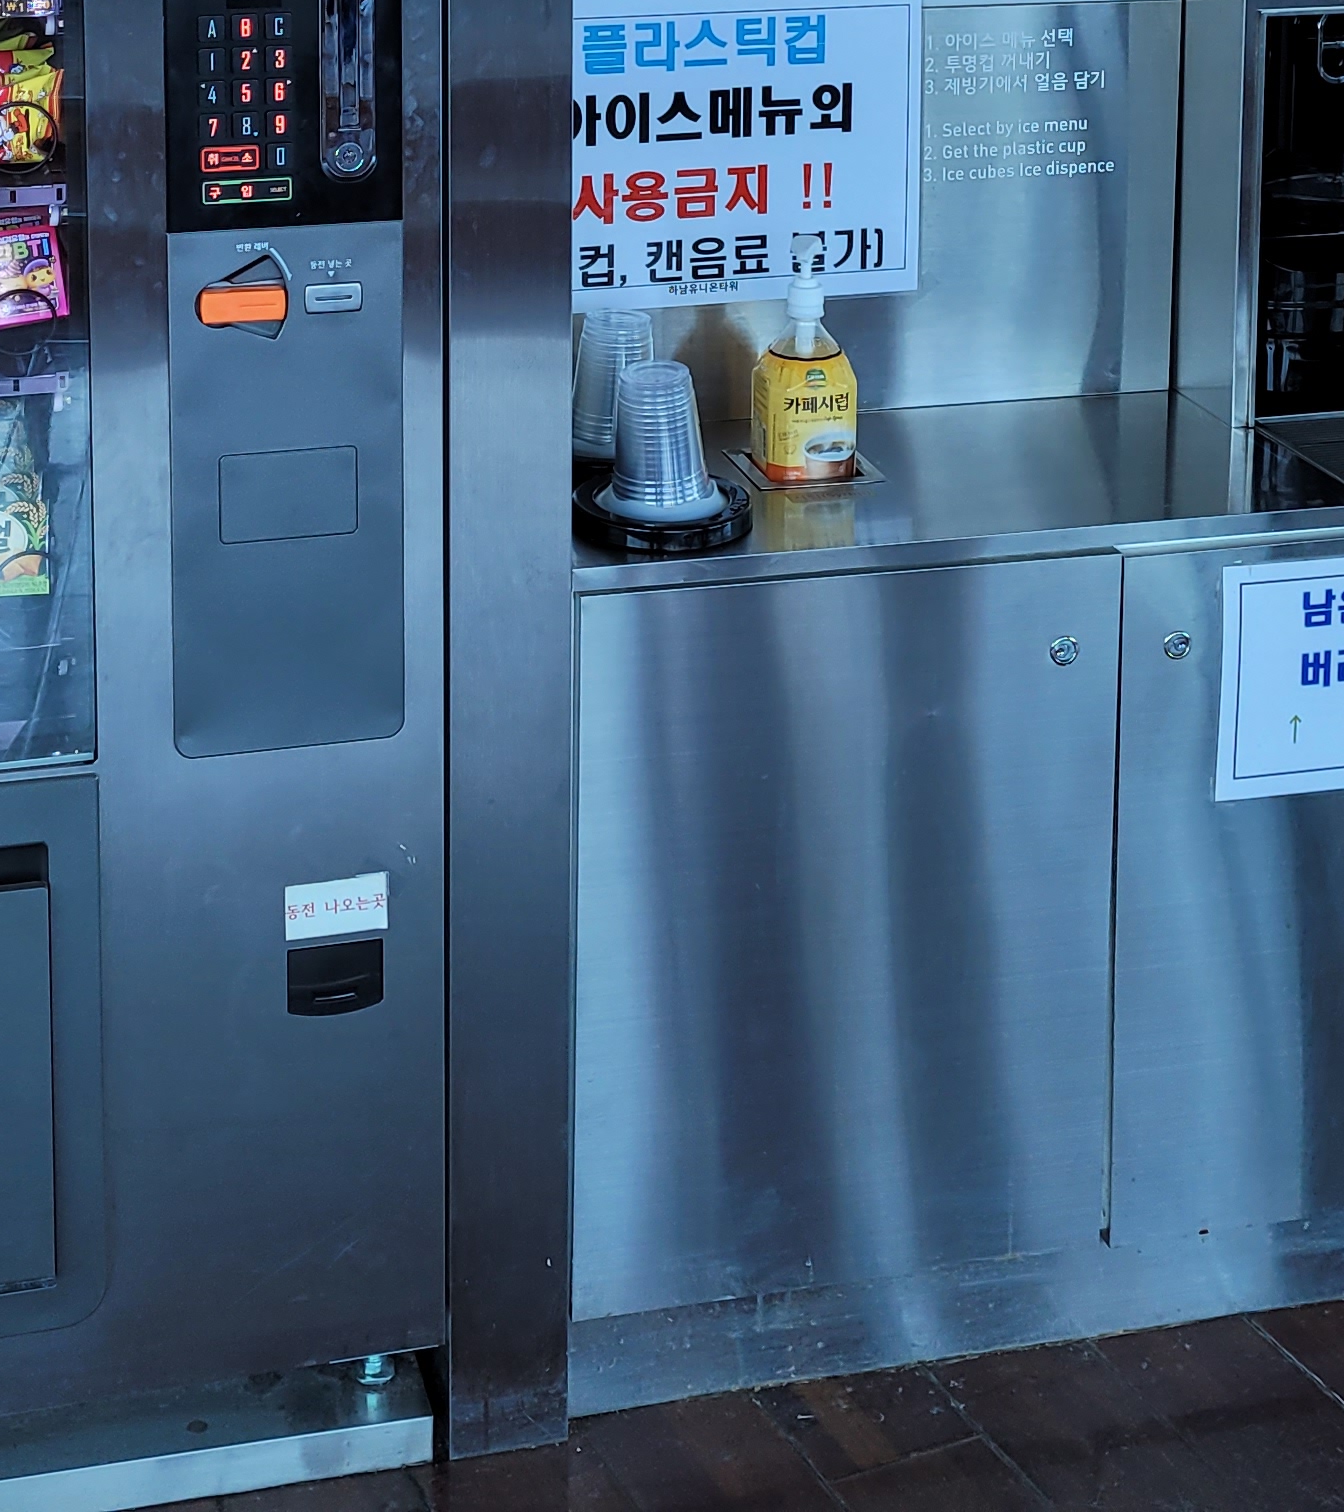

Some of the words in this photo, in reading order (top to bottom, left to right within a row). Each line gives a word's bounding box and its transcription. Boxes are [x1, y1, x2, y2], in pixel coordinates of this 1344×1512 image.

[582, 14, 827, 75] 플라스틱컵
[926, 35, 940, 51] 1.
[944, 33, 996, 51] 아이스
[1002, 32, 1036, 49] 메뉴
[1041, 27, 1073, 48] 선택
[925, 58, 939, 73] 2.
[945, 54, 994, 73] 투명컵
[1001, 51, 1050, 70] 꺼내기
[925, 79, 939, 95] 3.
[944, 74, 1028, 96] 제빙기에서
[1034, 72, 1068, 92] 얼음
[1074, 70, 1105, 90] 담기
[572, 82, 854, 147] 아이스메뉴외
[925, 124, 937, 138] 1.
[942, 122, 991, 138] Select
[996, 120, 1013, 136] by
[1018, 120, 1039, 133] ice
[1044, 117, 1088, 132] menu
[924, 145, 937, 160] 2.
[942, 145, 969, 160] Get
[973, 143, 998, 158] the
[1003, 139, 1054, 159] plastic
[1059, 140, 1086, 155] cup
[923, 167, 937, 182] 3.
[942, 167, 964, 181] Ice
[969, 164, 1014, 179] cubes
[1020, 162, 1041, 177] Ice
[1046, 159, 1115, 177] dispence
[572, 163, 768, 224] 사용금지
[802, 162, 833, 210] !!
[578, 243, 627, 288] 컵,
[645, 234, 770, 282] 캔음료
[668, 281, 739, 296] 하남유니온타워
[784, 392, 849, 414] 카페시럽
[285, 902, 315, 920] 동전
[325, 893, 386, 915] 나오는곳
